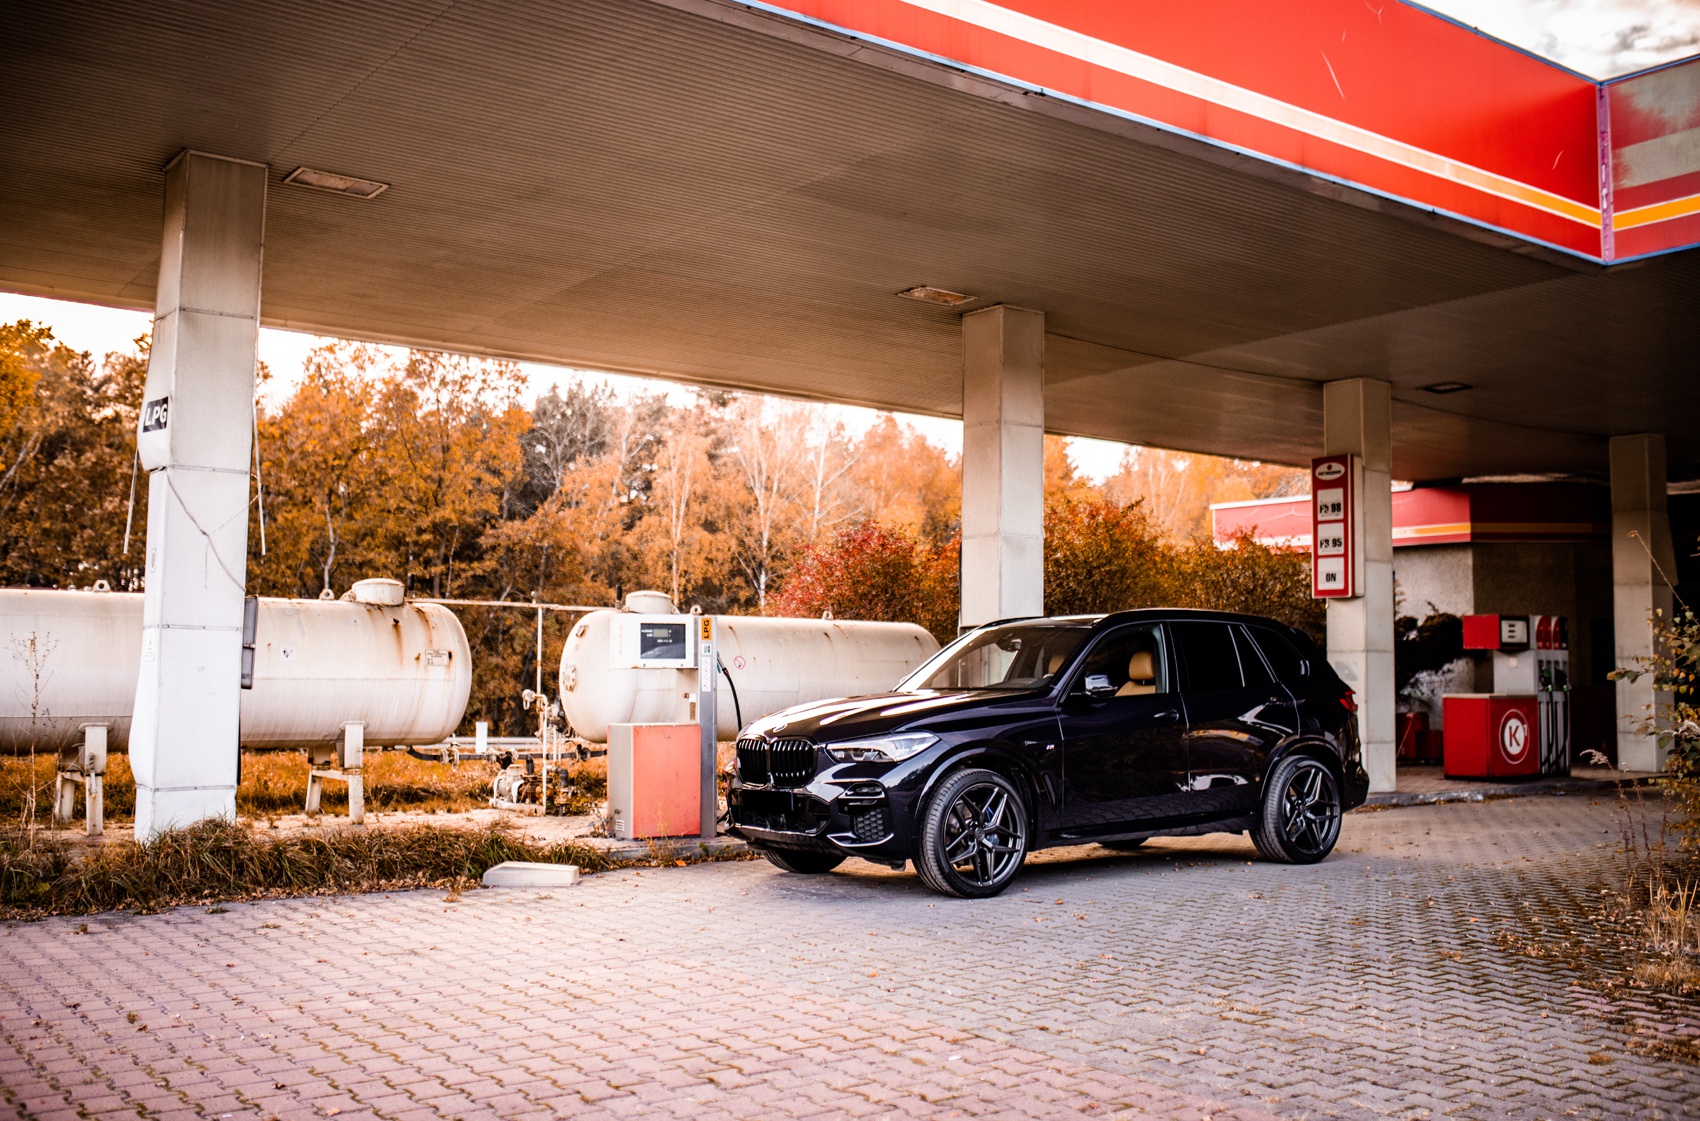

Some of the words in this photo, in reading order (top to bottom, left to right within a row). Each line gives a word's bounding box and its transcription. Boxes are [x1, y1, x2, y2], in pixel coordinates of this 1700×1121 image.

[144, 403, 168, 426] LPG
[1331, 502, 1342, 513] 98
[1332, 537, 1343, 548] 95
[1325, 572, 1337, 583] ON
